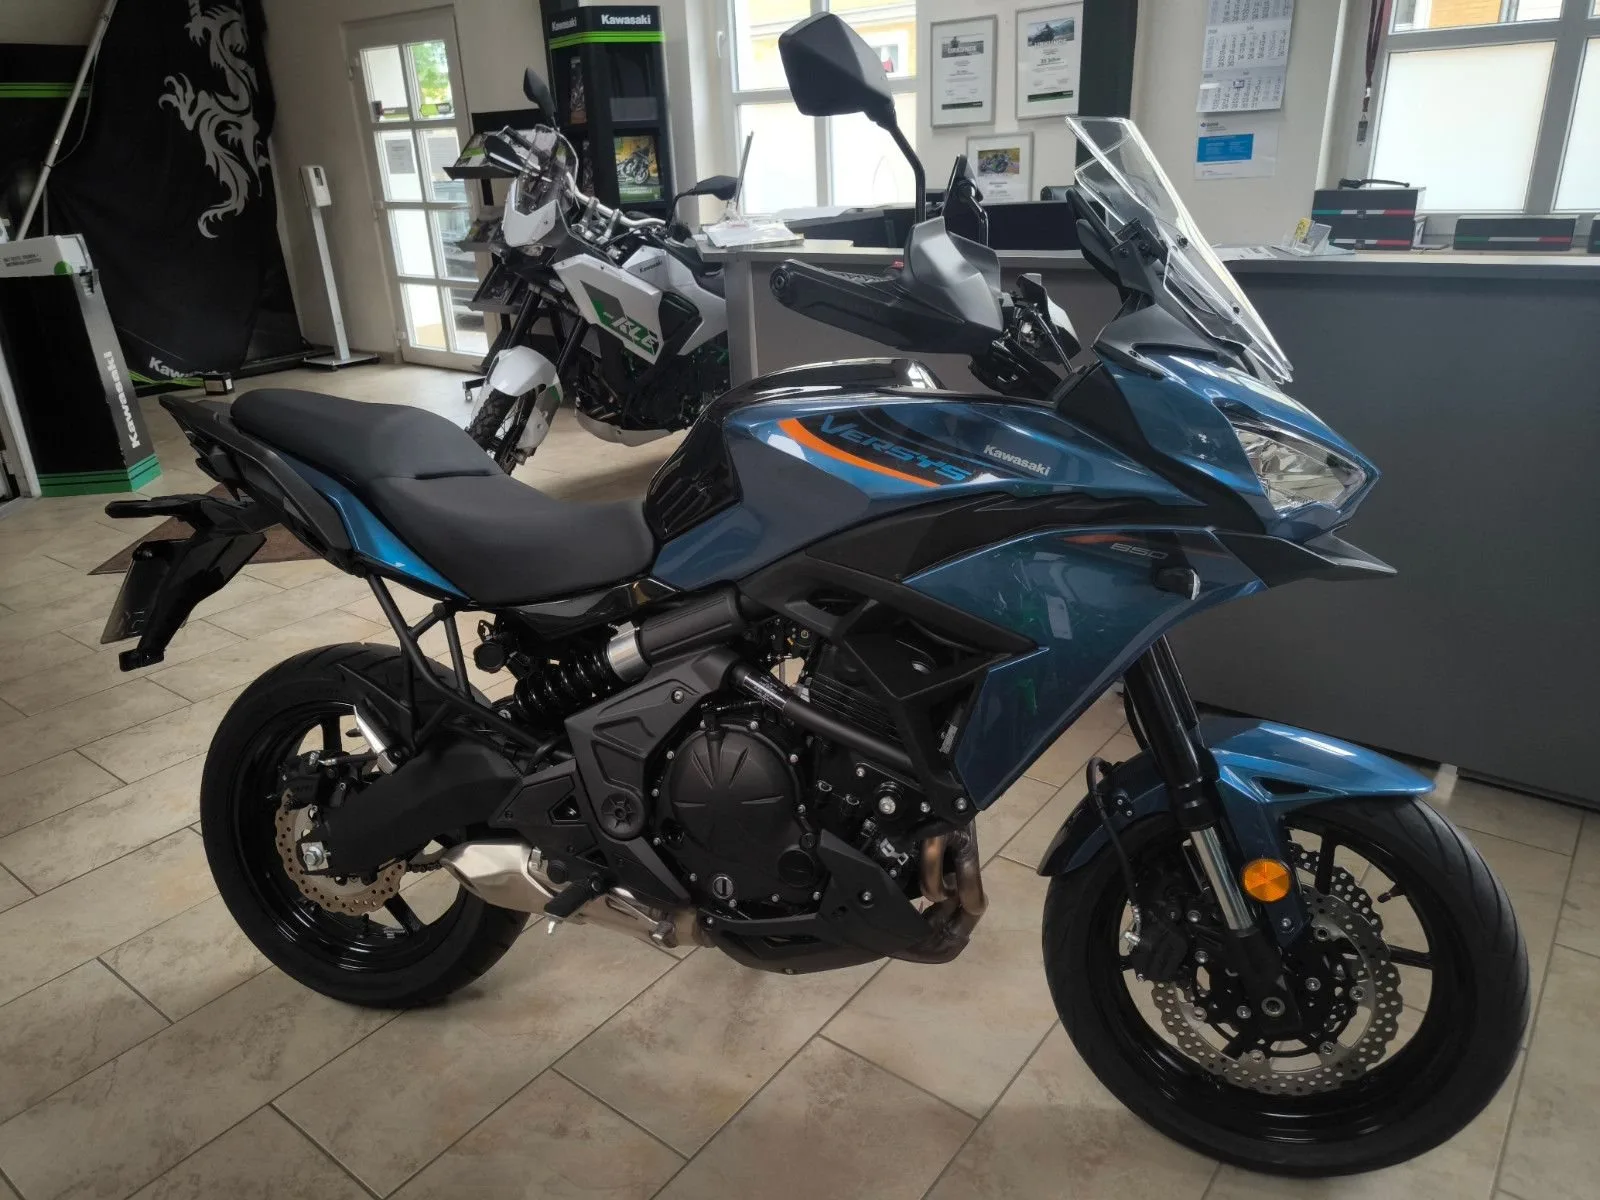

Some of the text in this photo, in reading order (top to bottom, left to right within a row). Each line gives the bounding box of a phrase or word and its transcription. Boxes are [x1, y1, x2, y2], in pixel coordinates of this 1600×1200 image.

[601, 14, 651, 25] Kawasaki
[103, 351, 140, 448] Kawasaki
[983, 444, 1051, 477] Kawasaki
[1109, 542, 1169, 560] 650
